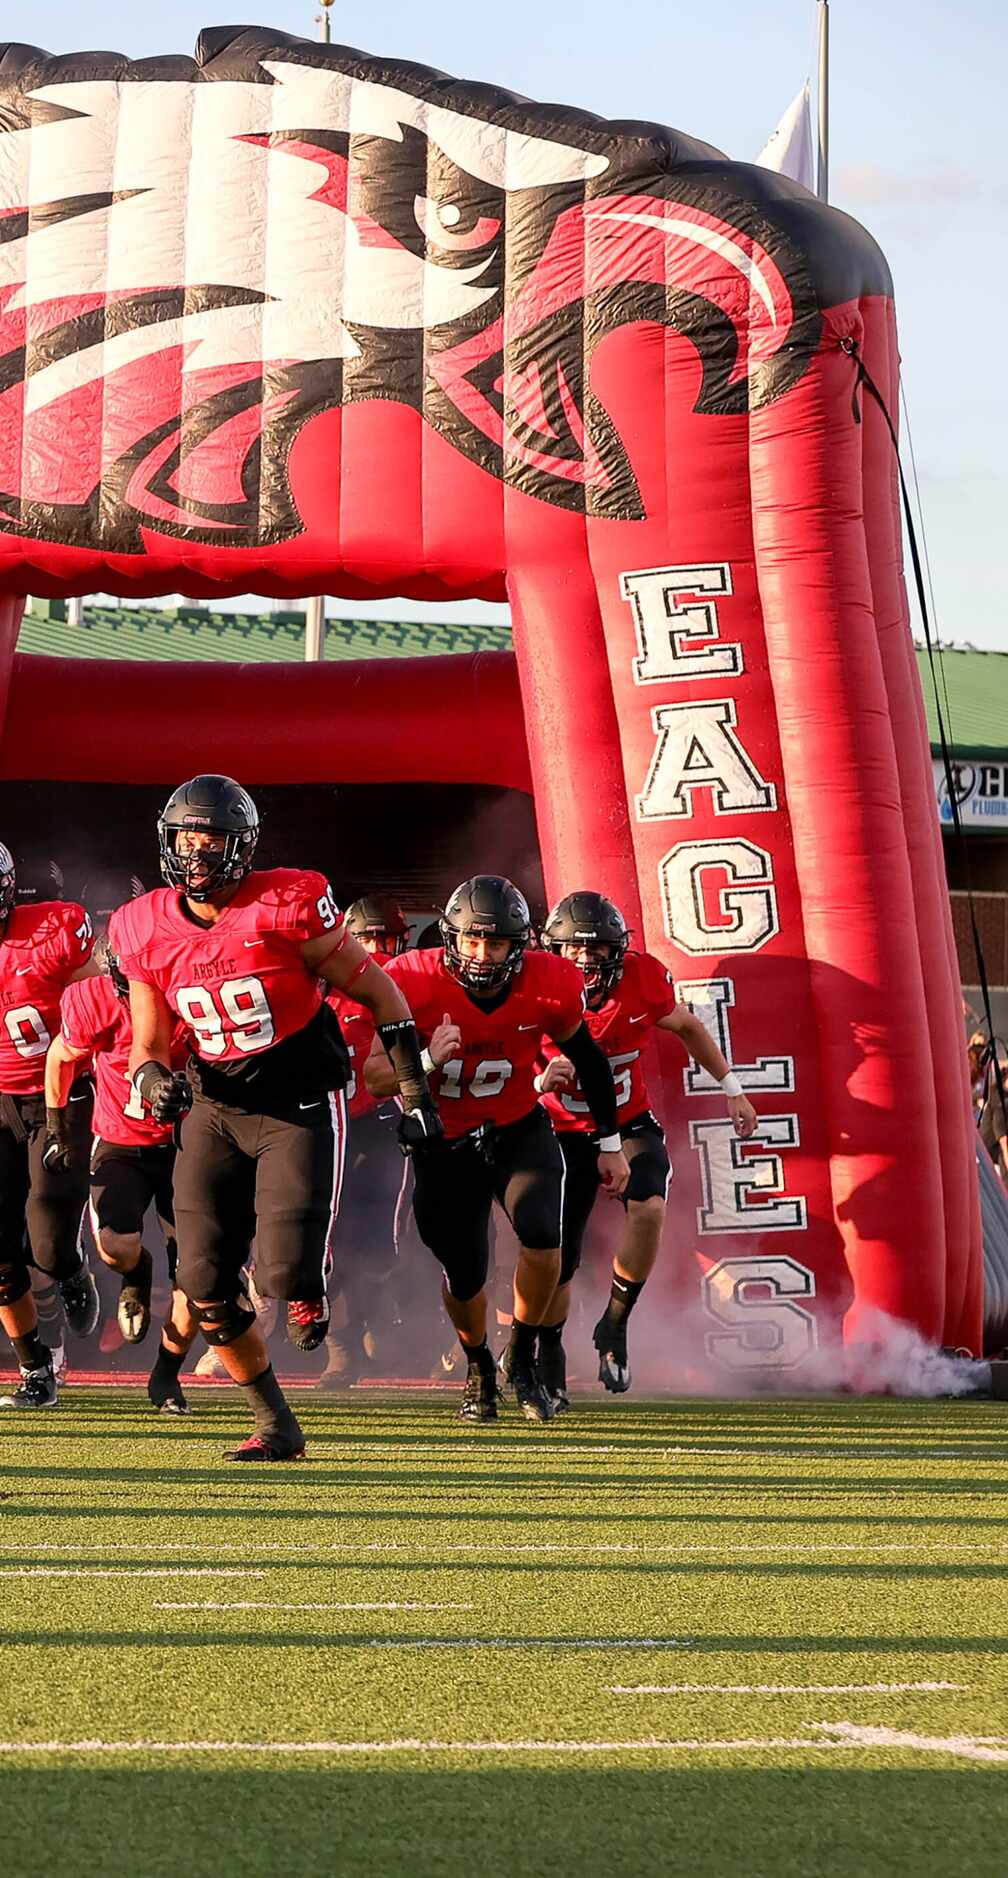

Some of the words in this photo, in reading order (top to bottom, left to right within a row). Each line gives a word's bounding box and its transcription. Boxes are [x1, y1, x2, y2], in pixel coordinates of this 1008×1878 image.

[192, 958, 238, 981] ARGYLE
[619, 562, 819, 1372] EAGLES
[175, 975, 278, 1056] 99
